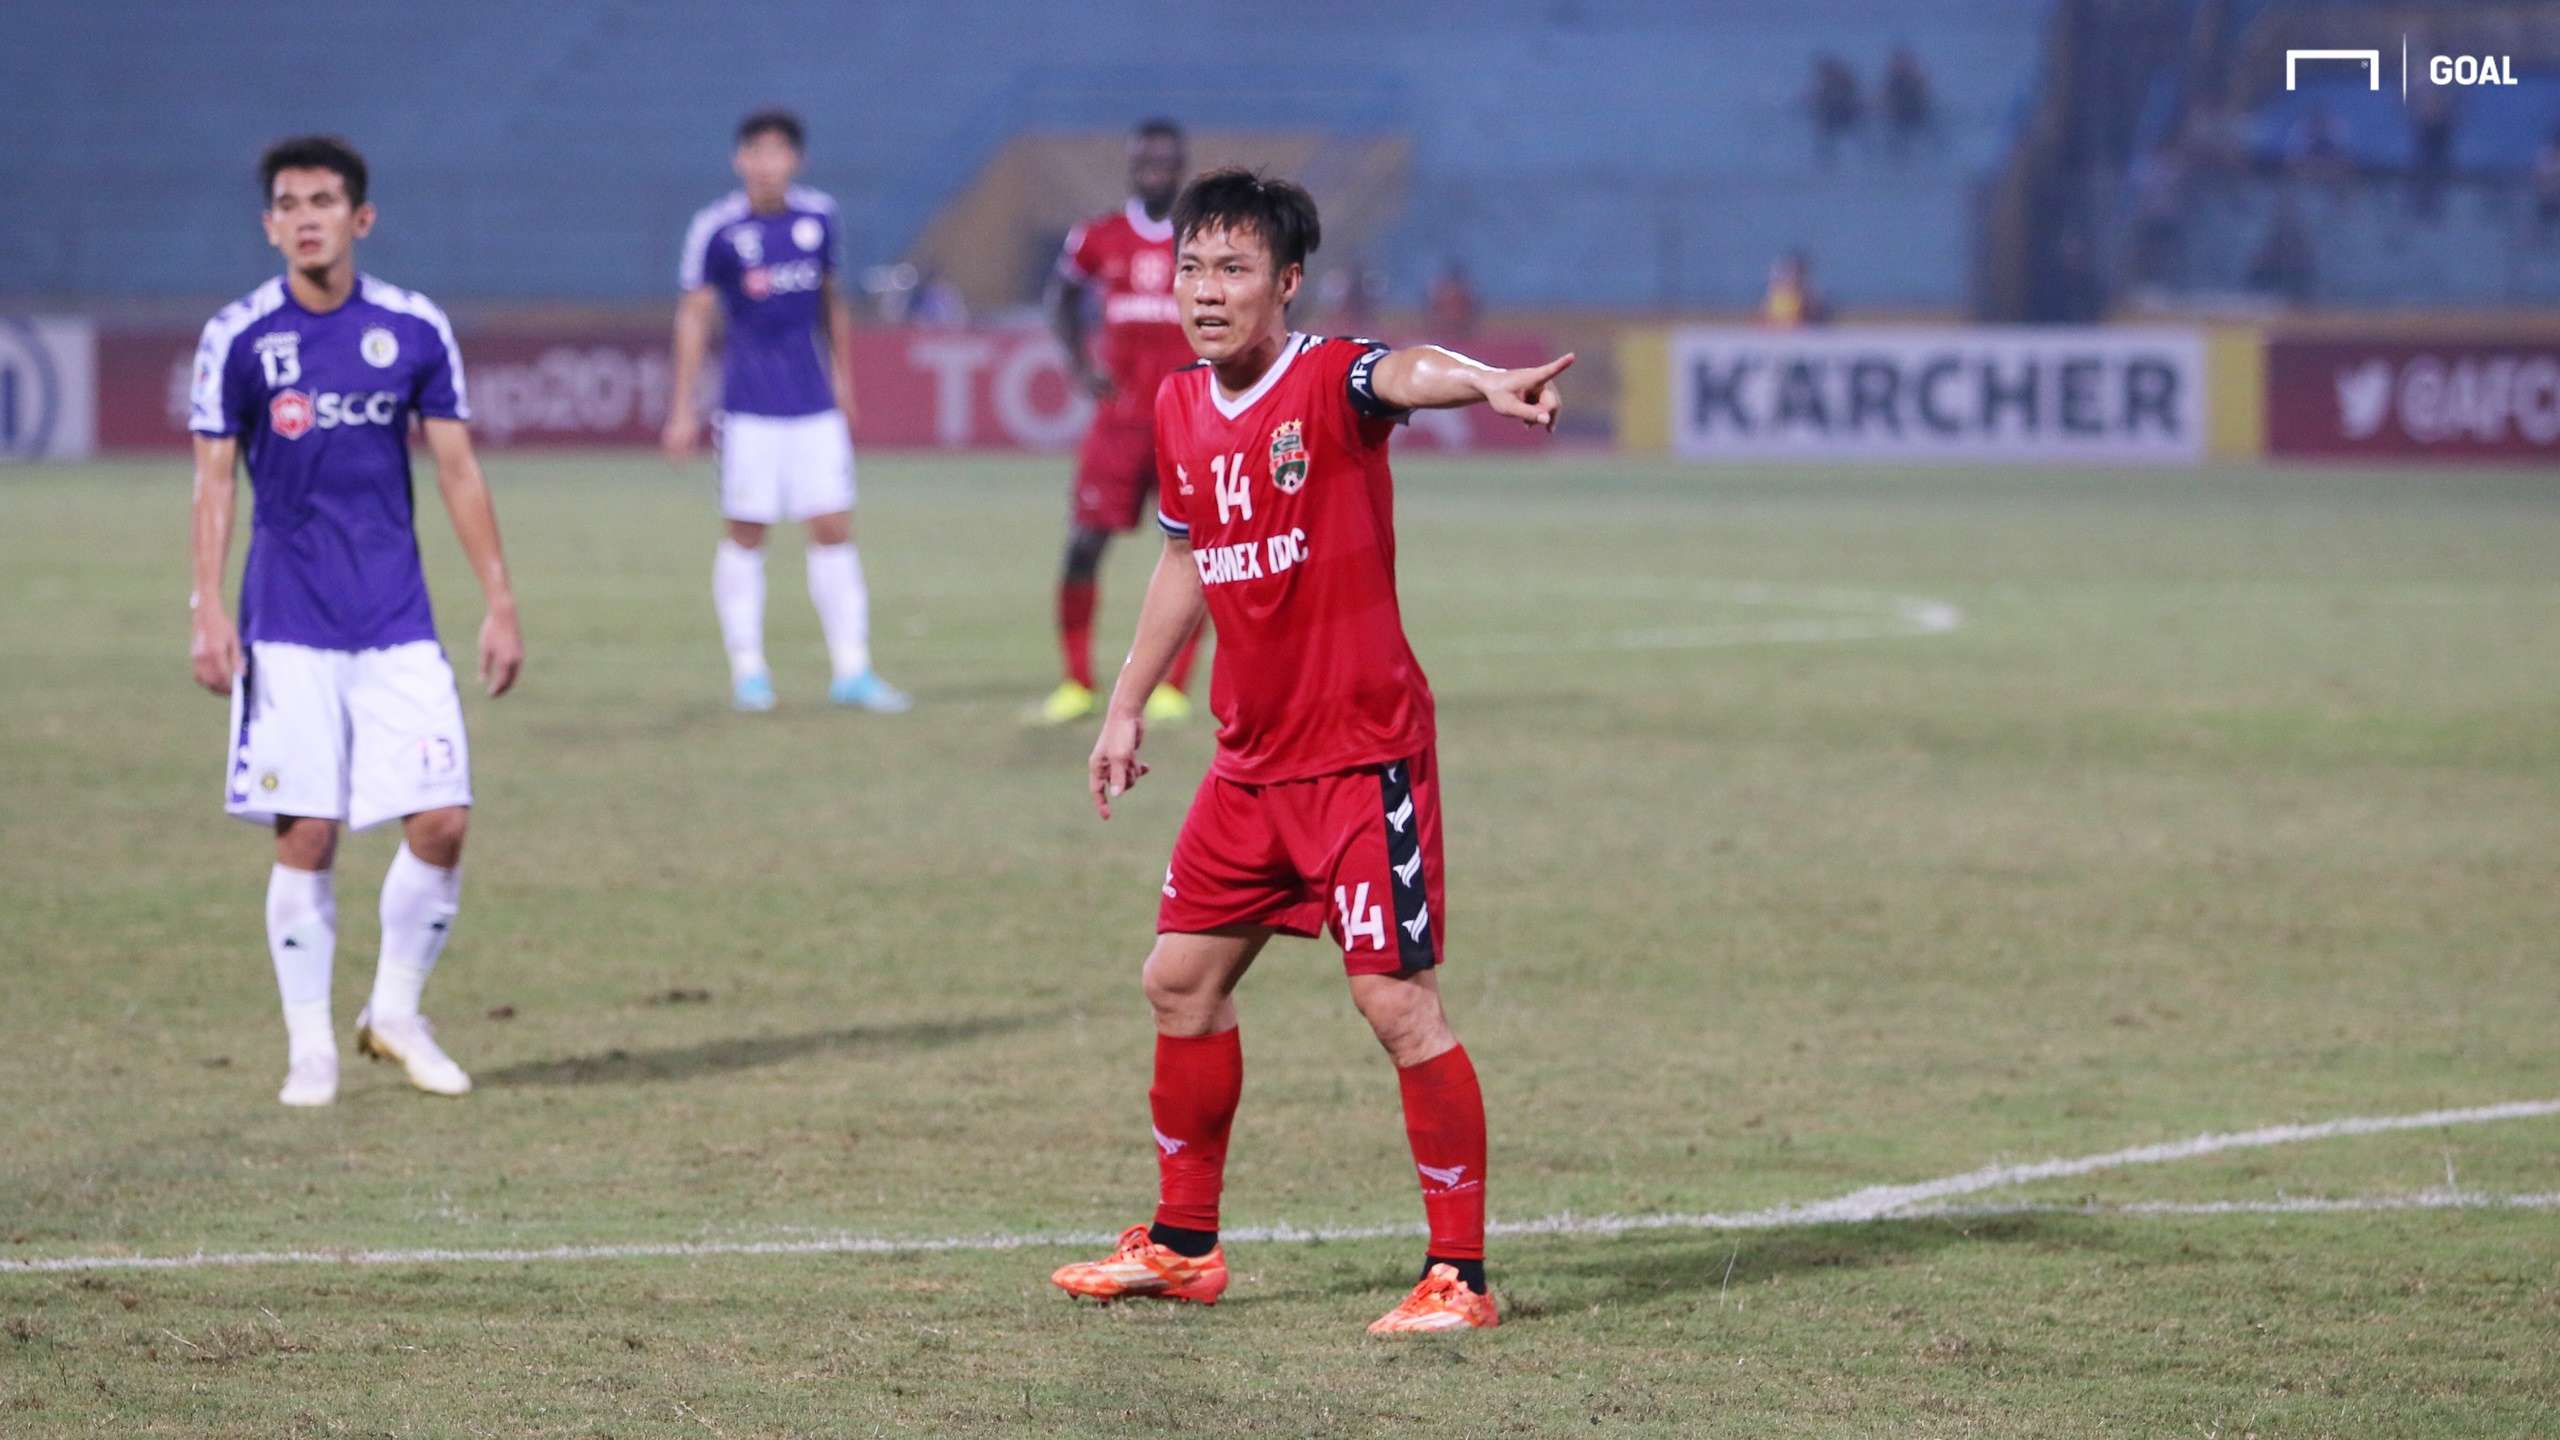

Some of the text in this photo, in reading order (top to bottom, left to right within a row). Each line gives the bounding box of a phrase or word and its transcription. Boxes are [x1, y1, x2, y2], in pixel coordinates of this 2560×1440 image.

[259, 347, 300, 388] 13
[1210, 452, 1252, 525] 14
[1267, 527, 1309, 574] IDC
[1334, 881, 1386, 952] 14
